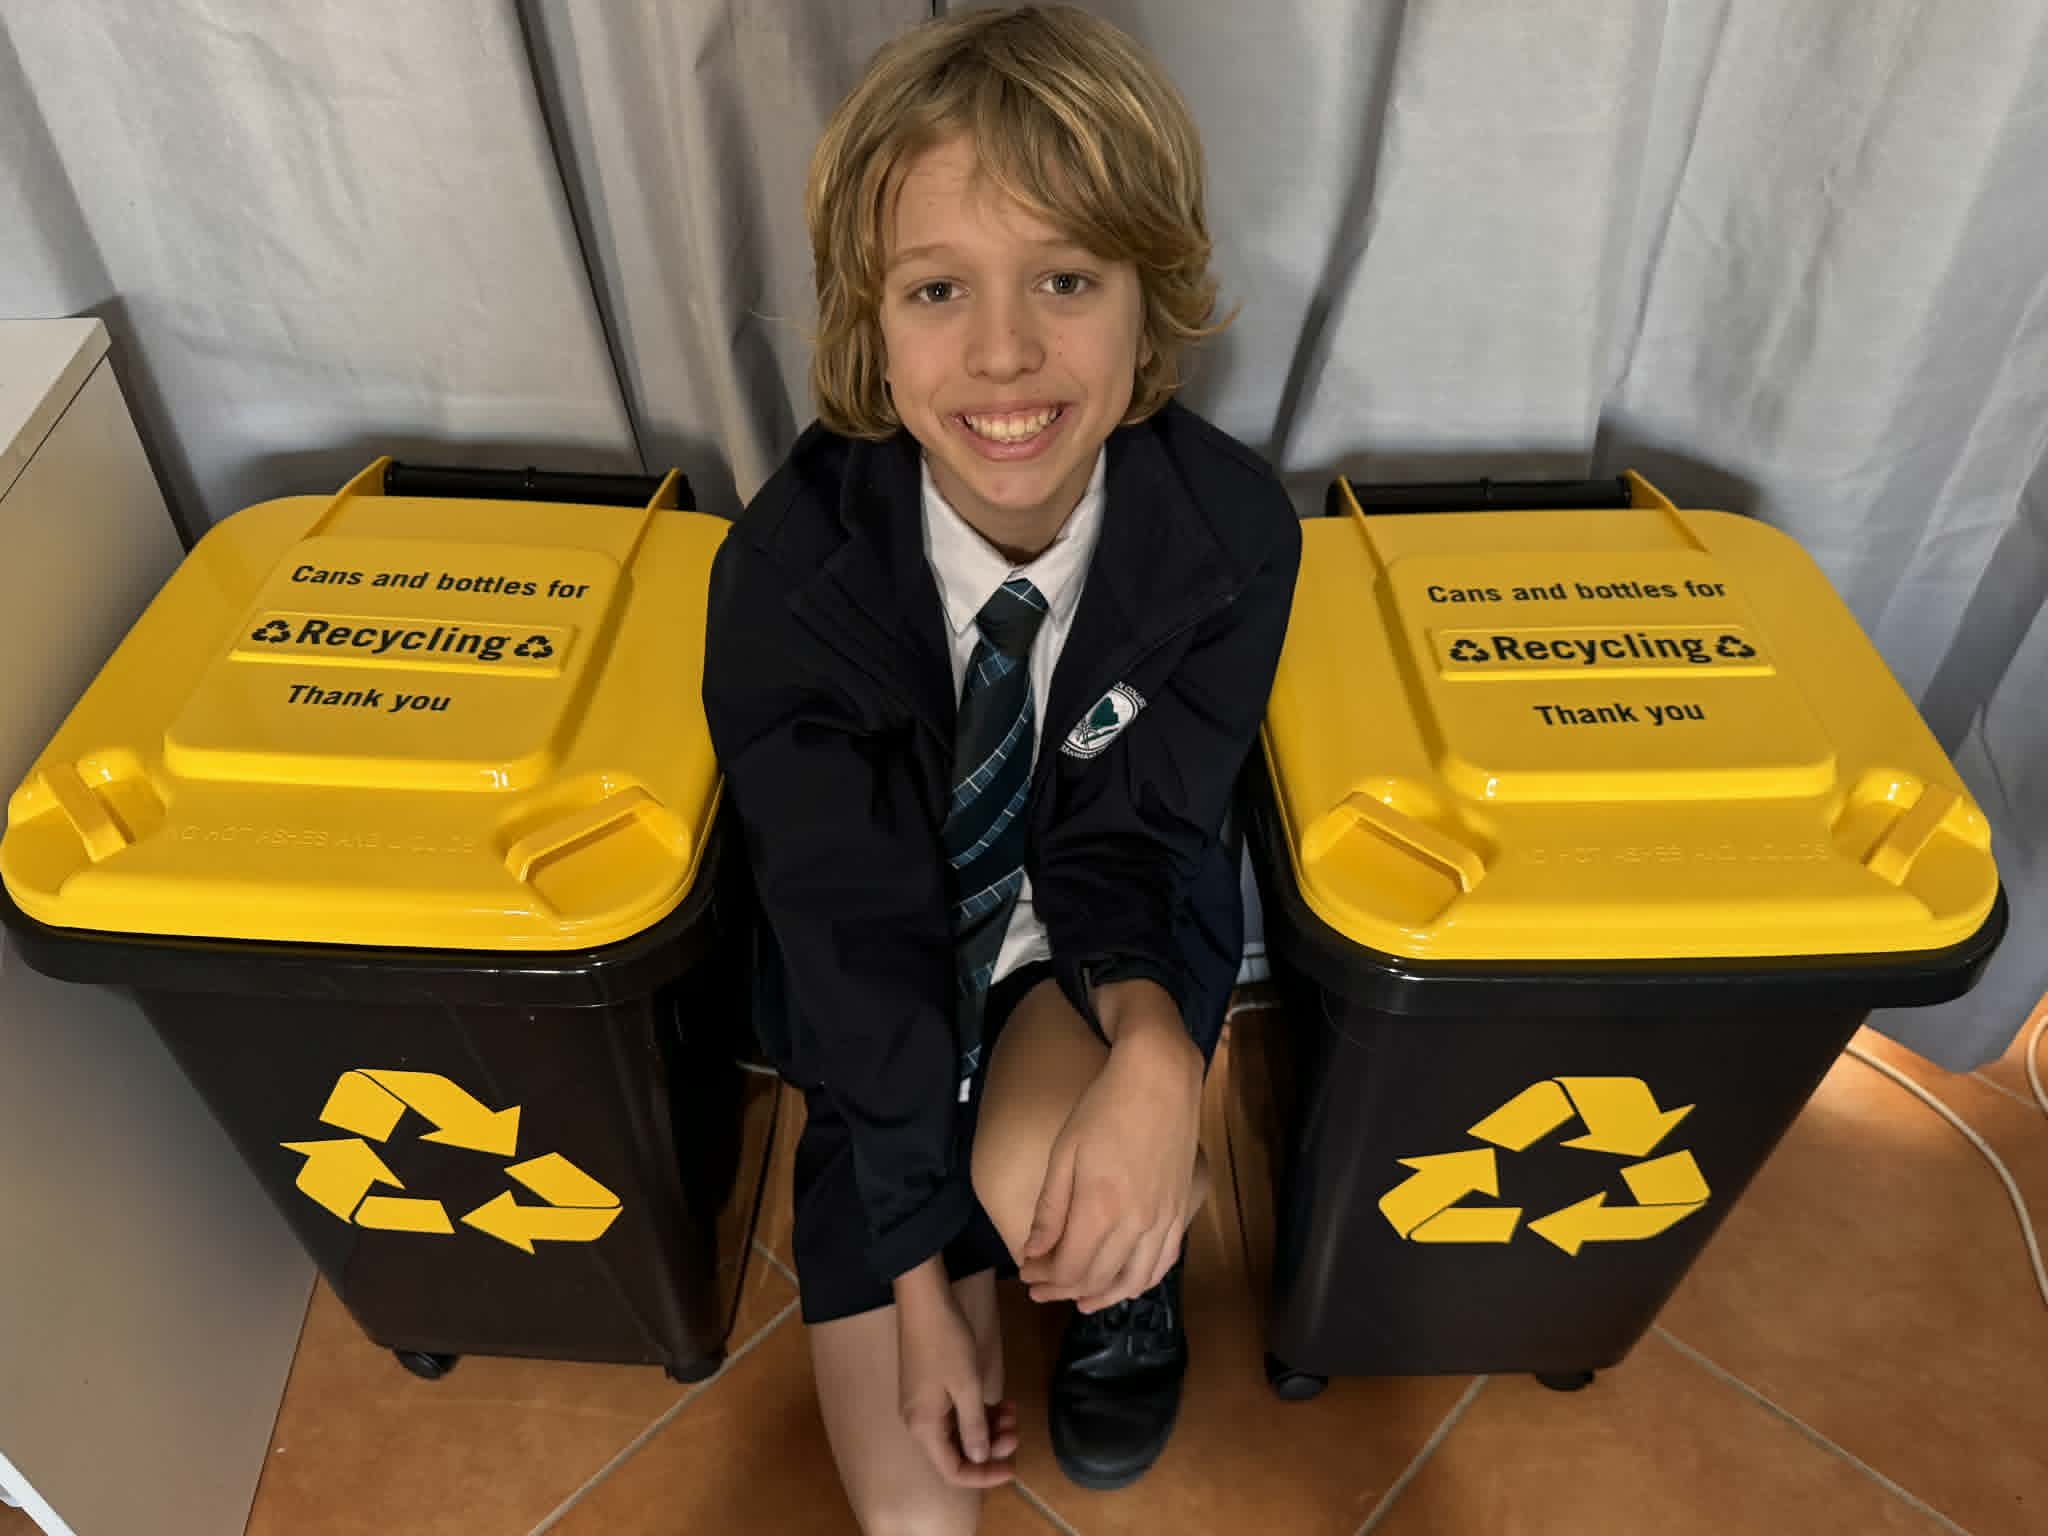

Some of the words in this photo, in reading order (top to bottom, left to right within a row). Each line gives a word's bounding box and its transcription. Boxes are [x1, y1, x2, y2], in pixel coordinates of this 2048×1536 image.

[291, 565, 364, 585] Cans
[371, 571, 430, 589] and
[436, 573, 537, 596] bottles
[547, 579, 590, 599] for
[1427, 585, 1503, 603] Cans
[1511, 583, 1568, 601] and
[1574, 581, 1678, 600] bottles
[1684, 580, 1725, 598] for
[295, 619, 512, 662] Recycling
[1491, 632, 1713, 665] Recycling
[287, 684, 383, 708] Thank
[387, 694, 451, 713] you
[1533, 703, 1639, 726] Thank
[1645, 704, 1705, 727] you
